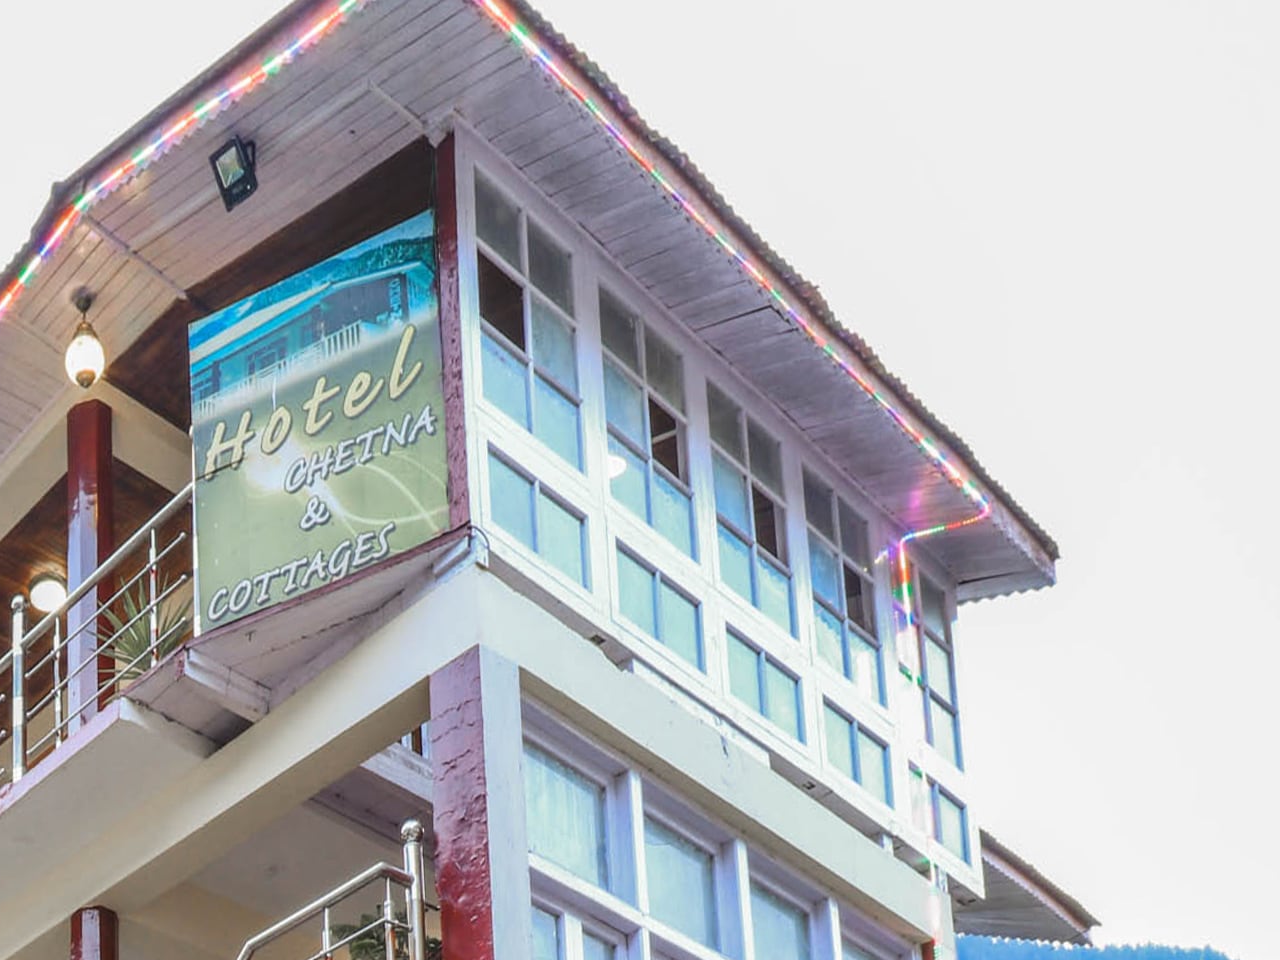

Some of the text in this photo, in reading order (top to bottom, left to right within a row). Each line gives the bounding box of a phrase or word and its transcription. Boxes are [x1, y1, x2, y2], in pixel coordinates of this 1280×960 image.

[205, 324, 422, 481] Hotel
[285, 404, 437, 493] CHETNA
[300, 496, 330, 530] &
[208, 522, 396, 621] COTTAGES
